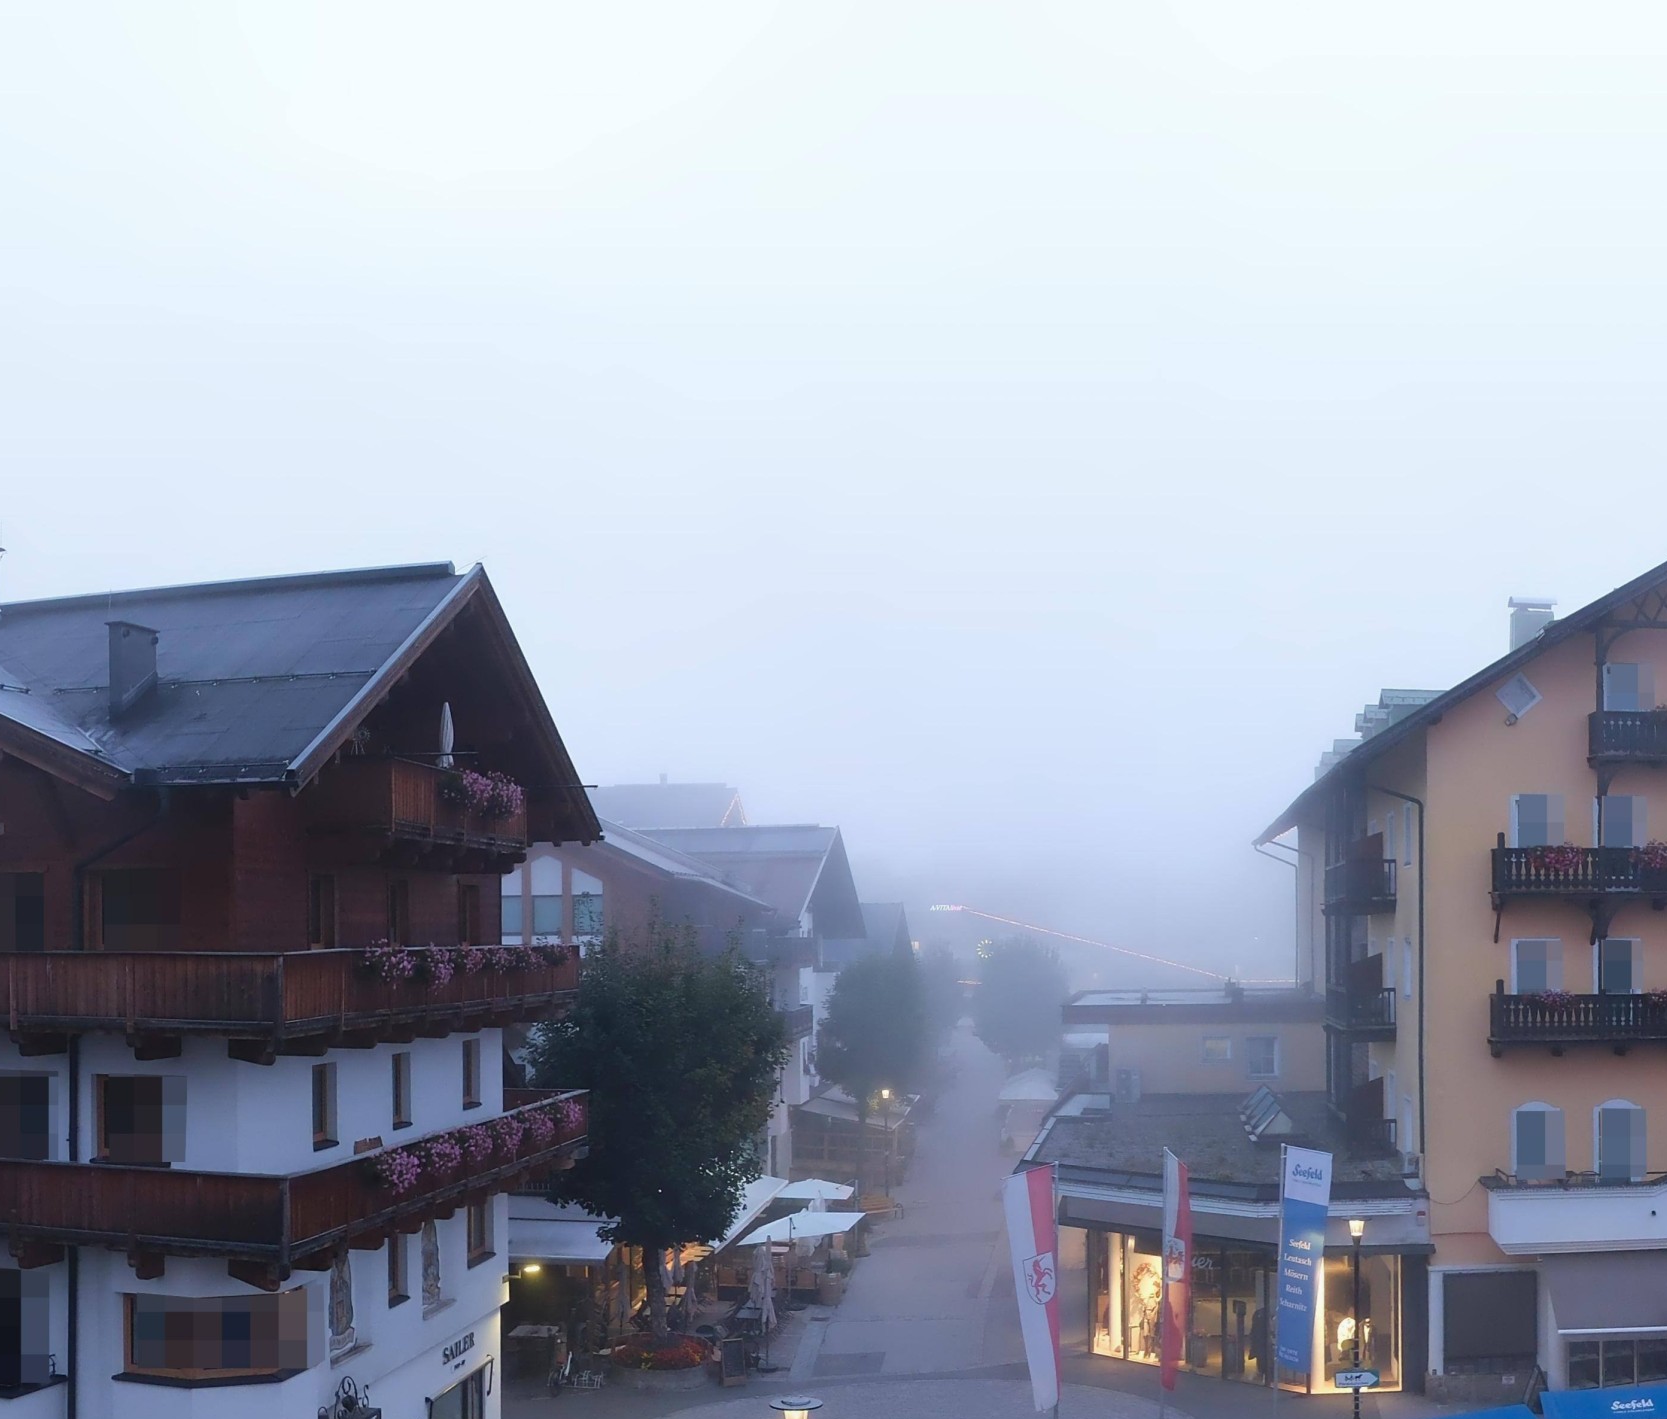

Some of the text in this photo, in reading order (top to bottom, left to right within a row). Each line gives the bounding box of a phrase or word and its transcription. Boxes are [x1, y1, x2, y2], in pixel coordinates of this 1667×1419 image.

[1292, 1163, 1323, 1181] Seefeld
[1288, 1238, 1311, 1251] Seefeld
[1284, 1253, 1312, 1266] Leutasch
[1284, 1268, 1308, 1280] Mösern
[1285, 1284, 1303, 1295] Reith
[442, 1332, 475, 1365] SAILER
[1611, 1398, 1654, 1413] Seefeld
